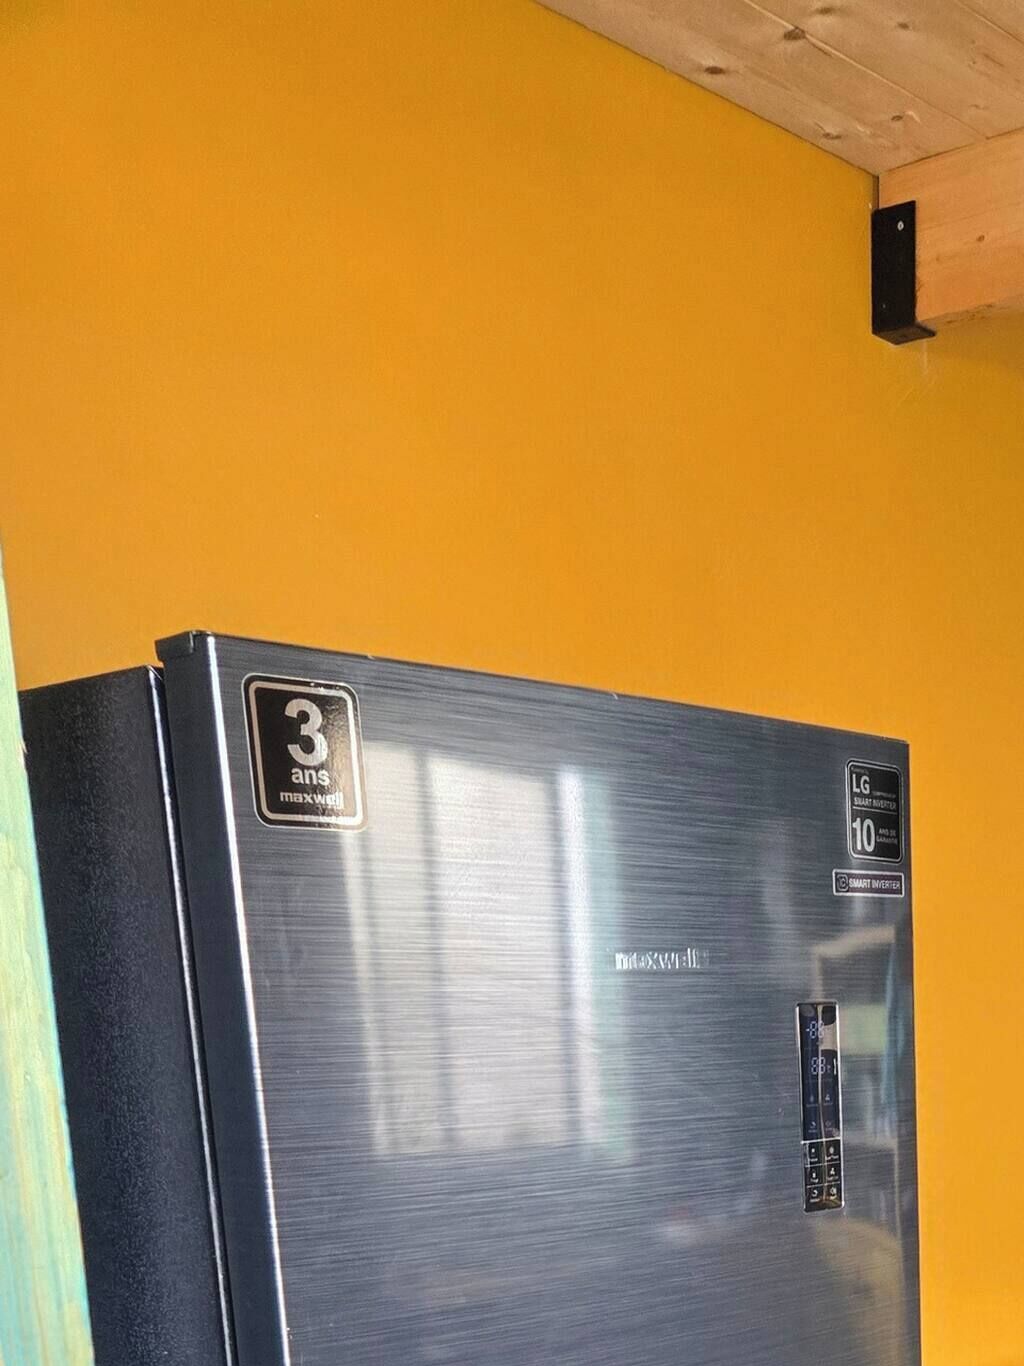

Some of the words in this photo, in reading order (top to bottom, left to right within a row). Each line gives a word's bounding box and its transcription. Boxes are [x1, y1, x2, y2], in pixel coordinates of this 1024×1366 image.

[284, 698, 328, 766] 3
[291, 768, 330, 785] ans
[852, 774, 870, 795] LG
[854, 797, 872, 807] SMART
[873, 799, 897, 810] INVERTER
[852, 817, 876, 852] 10
[849, 878, 871, 888] SMART
[872, 879, 901, 890] INVERTER
